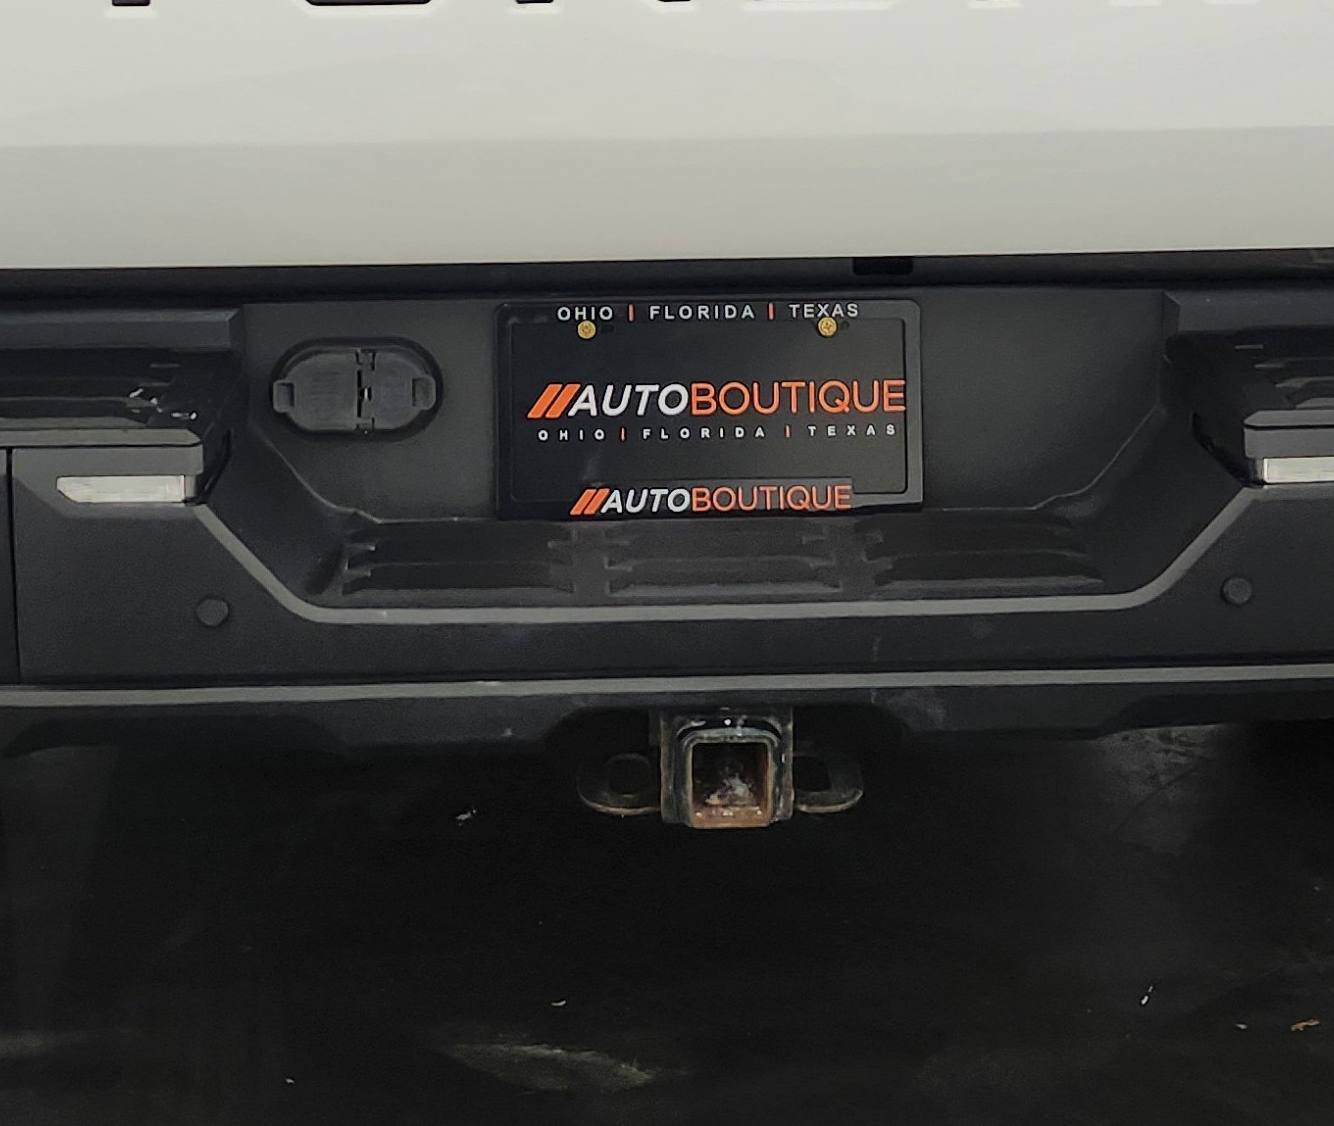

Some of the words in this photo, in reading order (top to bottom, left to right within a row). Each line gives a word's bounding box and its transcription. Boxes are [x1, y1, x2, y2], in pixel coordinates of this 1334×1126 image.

[556, 305, 614, 322] OHIO
[649, 304, 755, 321] FLORIDA
[789, 303, 859, 318] TEXAS
[537, 428, 606, 441] OHIO
[642, 426, 765, 440] FLORIDA
[808, 424, 896, 438] TEXAS
